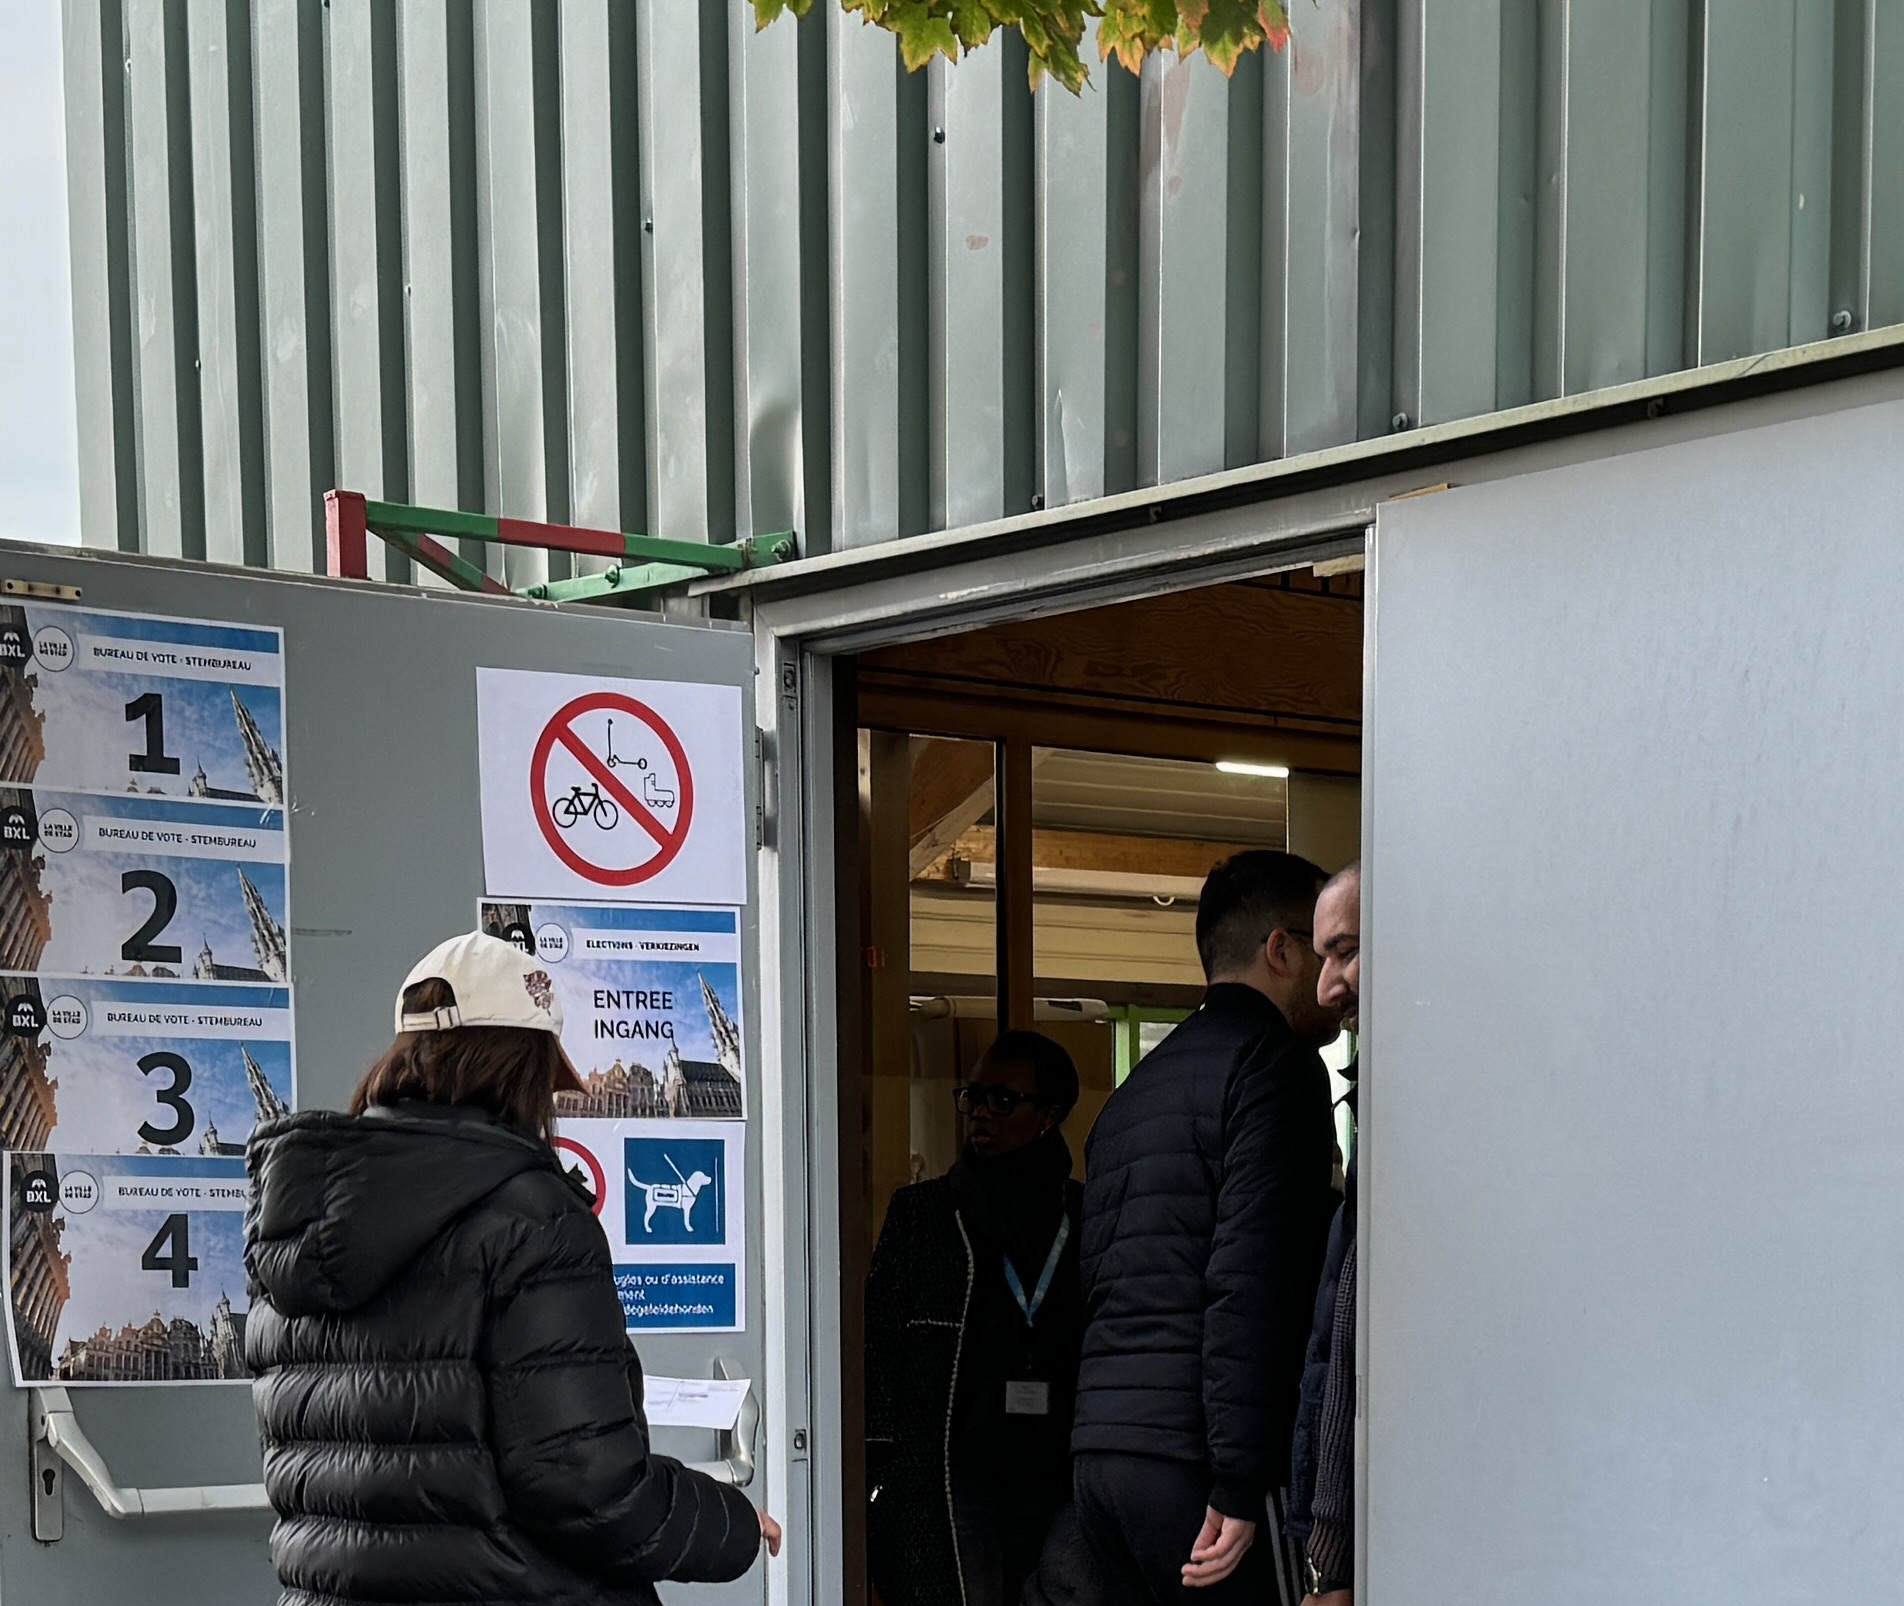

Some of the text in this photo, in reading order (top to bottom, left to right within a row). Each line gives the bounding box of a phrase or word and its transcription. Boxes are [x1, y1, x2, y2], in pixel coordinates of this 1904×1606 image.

[93, 647, 134, 660] BUREAU
[136, 651, 149, 661] DE
[151, 653, 177, 664] VOTE
[185, 656, 251, 671] STEMBUREAU
[125, 692, 180, 775] 1
[3, 826, 31, 840] BXL
[99, 827, 139, 840] BUREAU
[141, 831, 154, 841] DE
[156, 832, 183, 843] VOTE
[191, 835, 257, 848] STEMBUREAU
[121, 869, 182, 964] 2
[586, 939, 633, 949] ELECTIONS
[593, 989, 673, 1010] ENTREE
[12, 1014, 39, 1028] BXL
[107, 1012, 146, 1023] BUREAU
[148, 1014, 161, 1024] DE
[164, 1015, 189, 1025] VOTE
[198, 1016, 263, 1027] STEMBUREAU
[594, 1019, 674, 1039] INGANG
[136, 1051, 195, 1146] 3
[26, 1190, 52, 1203] BXL
[118, 1186, 158, 1197] BUREAU
[160, 1187, 173, 1197] DE
[175, 1187, 201, 1197] VOTE
[141, 1213, 199, 1288] 4
[614, 1273, 724, 1287] ugles ou d'assistance
[617, 1289, 645, 1300] ment
